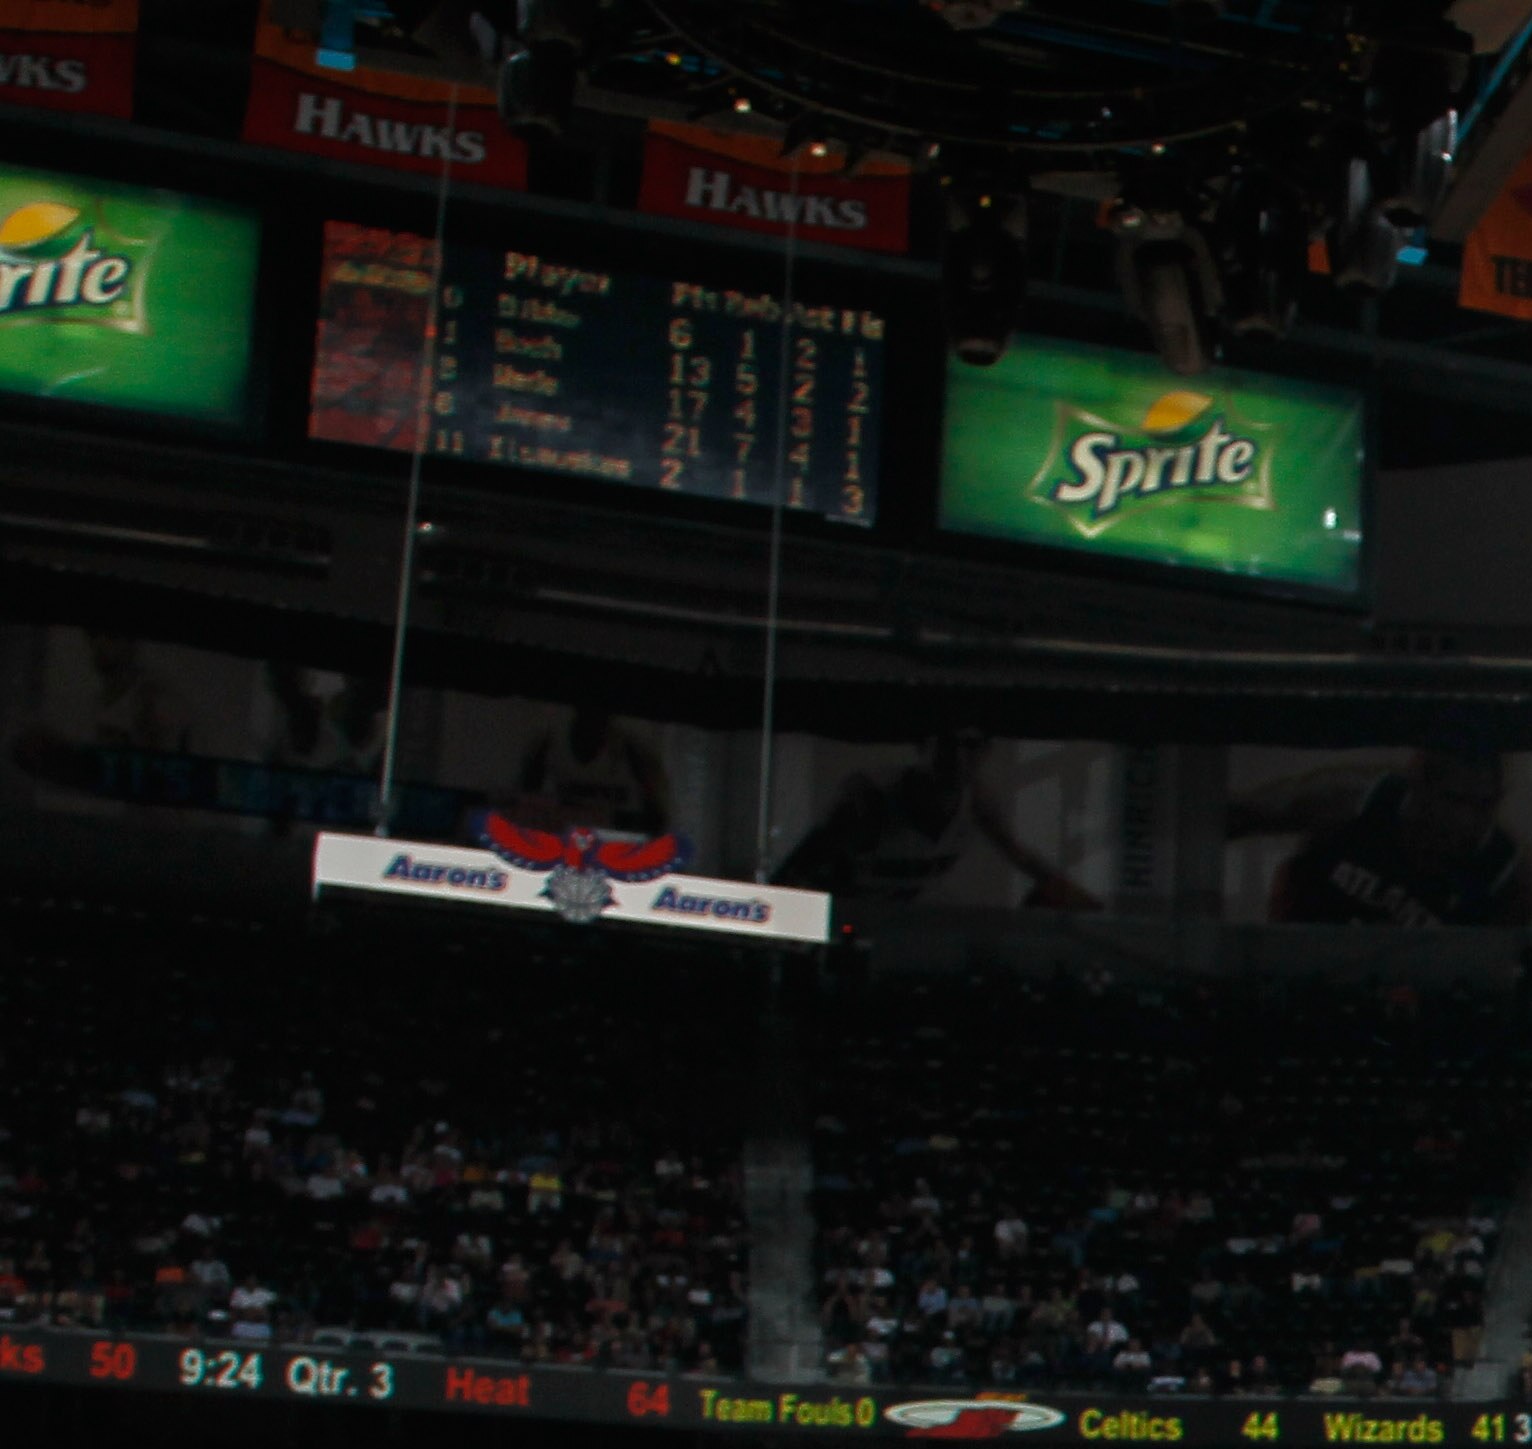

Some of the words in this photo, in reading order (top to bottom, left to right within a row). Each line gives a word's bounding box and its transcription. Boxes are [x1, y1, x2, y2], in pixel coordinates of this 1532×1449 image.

[293, 91, 488, 165] HAWKS
[682, 165, 869, 231] HAWKS
[668, 351, 712, 389] 13
[735, 361, 759, 396] 5
[792, 372, 816, 405] 2
[847, 381, 871, 414] 2
[795, 337, 818, 371] 2
[667, 387, 710, 421] 17
[660, 421, 702, 458] 21
[1055, 414, 1257, 520] Sprite
[658, 456, 685, 491] 2
[841, 483, 866, 516] 3
[383, 853, 507, 891] Aaron's
[653, 886, 773, 923] Aaron's
[89, 1341, 137, 1381] 50
[178, 1346, 266, 1391] 9:24
[283, 1354, 361, 1398] Qtr.
[368, 1360, 398, 1400] 3
[445, 1366, 532, 1408] Heat
[626, 1380, 670, 1417] 64
[700, 1388, 776, 1425] Team
[1077, 1407, 1185, 1443] Celtics
[1241, 1410, 1280, 1441] 44
[1322, 1411, 1446, 1443] Wizards
[1470, 1412, 1507, 1442] 41
